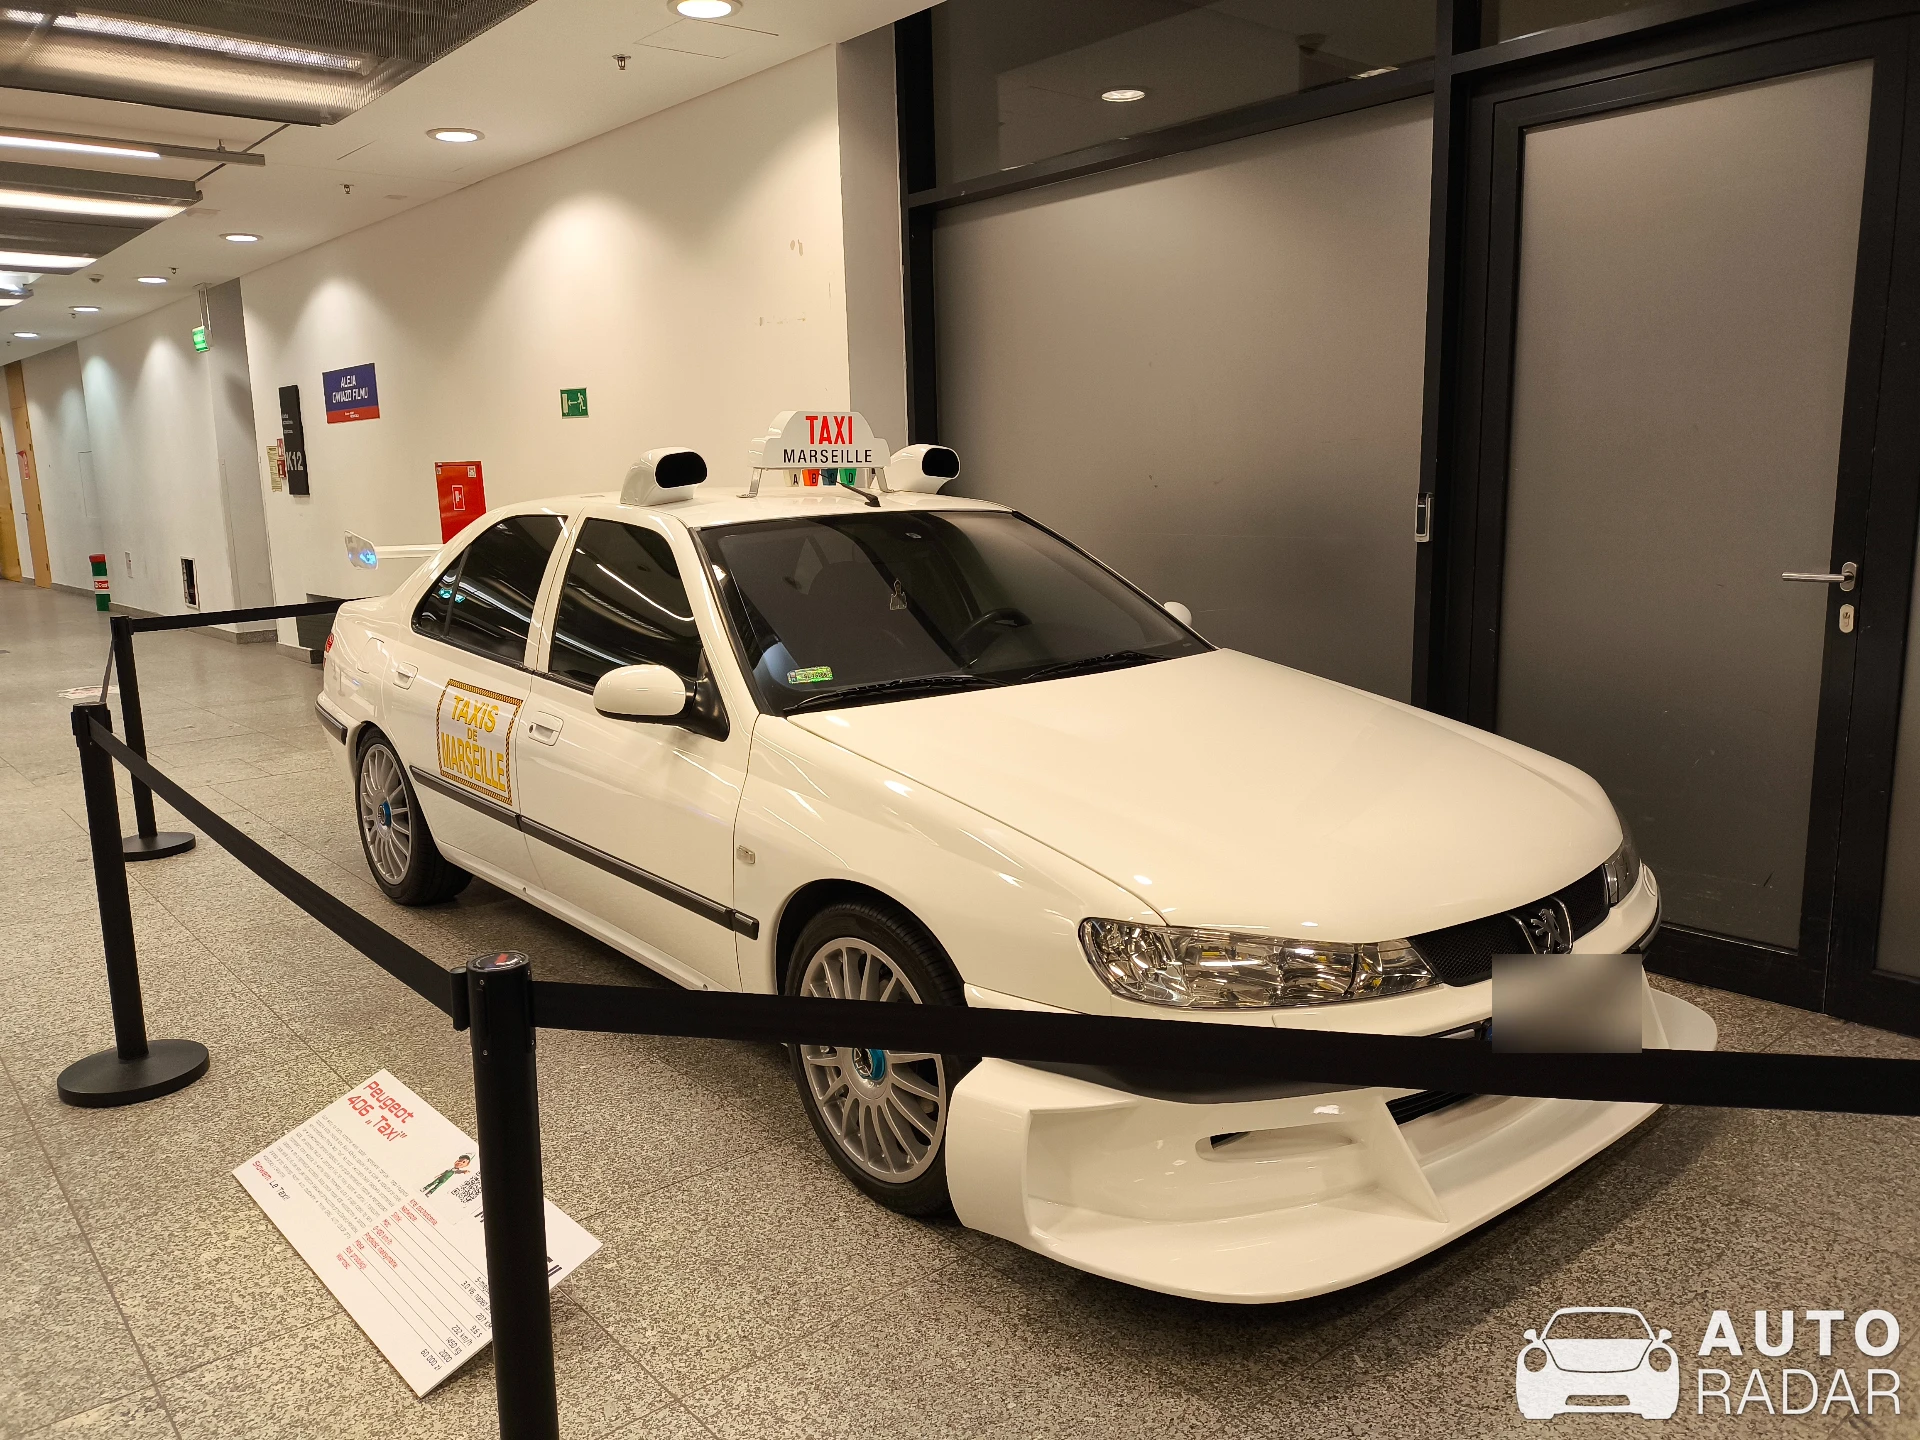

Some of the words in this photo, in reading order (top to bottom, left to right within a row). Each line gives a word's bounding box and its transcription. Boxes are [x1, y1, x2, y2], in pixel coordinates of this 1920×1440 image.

[341, 374, 357, 389] ALEJA
[353, 386, 369, 401] FILMU
[805, 415, 853, 445] TAXI
[286, 451, 304, 471] K12
[783, 448, 873, 464] MARSEILLE
[792, 473, 799, 486] A
[811, 472, 817, 484] B
[848, 472, 854, 484] D
[451, 694, 500, 734] TAXIS
[466, 726, 478, 743] DE
[440, 731, 507, 793] MARSEILLE
[347, 1095, 375, 1117] 406
[363, 1080, 414, 1124] Peugeot
[269, 1180, 279, 1189] Le
[438, 1349, 453, 1363] 2000
